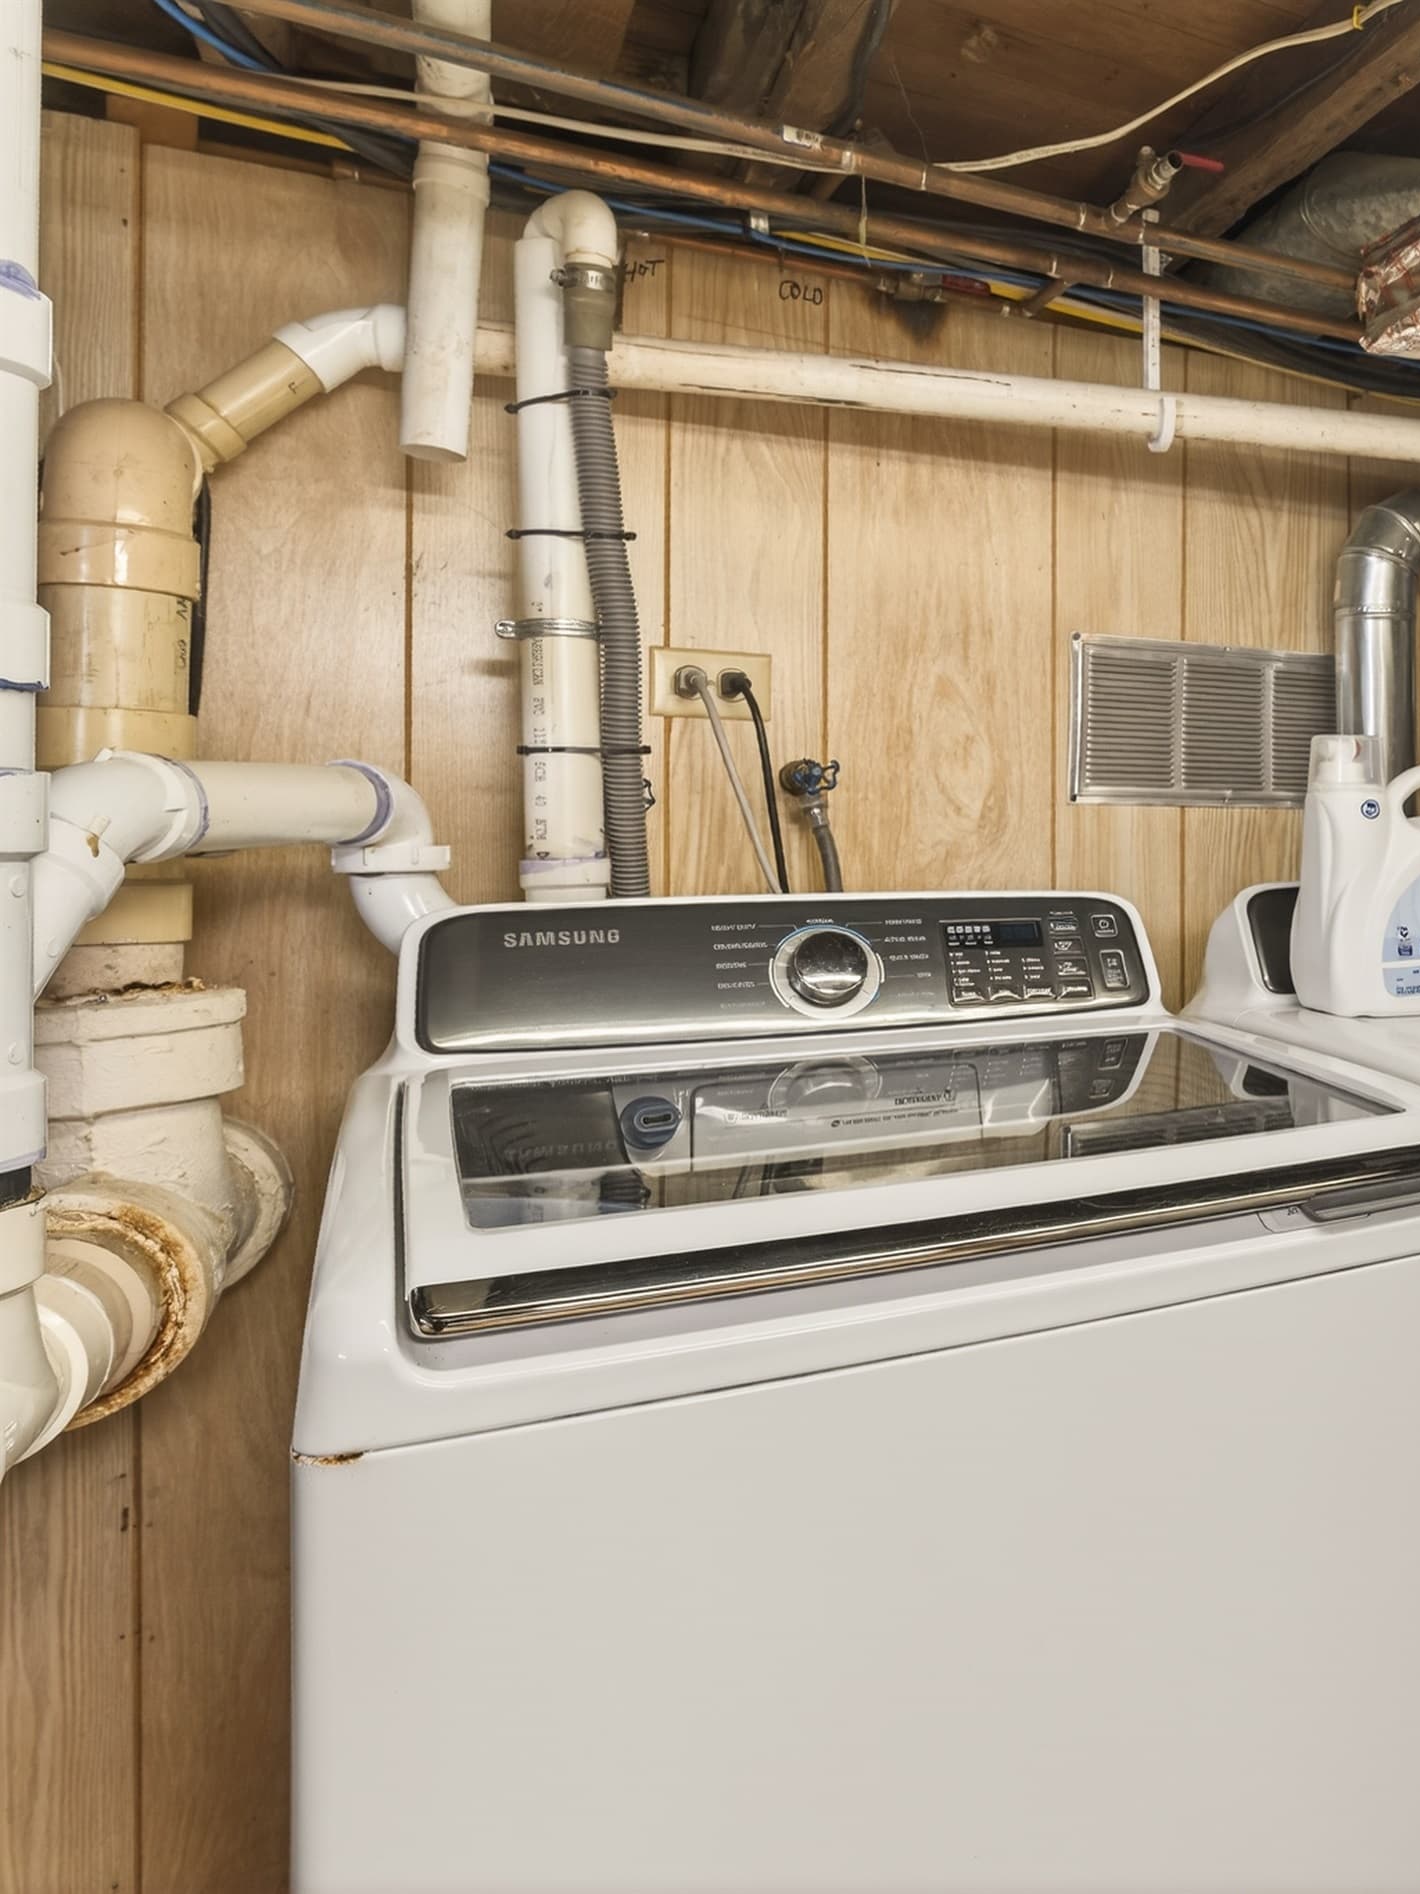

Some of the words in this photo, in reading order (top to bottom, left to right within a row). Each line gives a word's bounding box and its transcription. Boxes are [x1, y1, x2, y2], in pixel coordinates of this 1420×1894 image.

[624, 259, 665, 283] HOT
[779, 279, 823, 306] COLD
[503, 928, 621, 949] SAMSUNG
